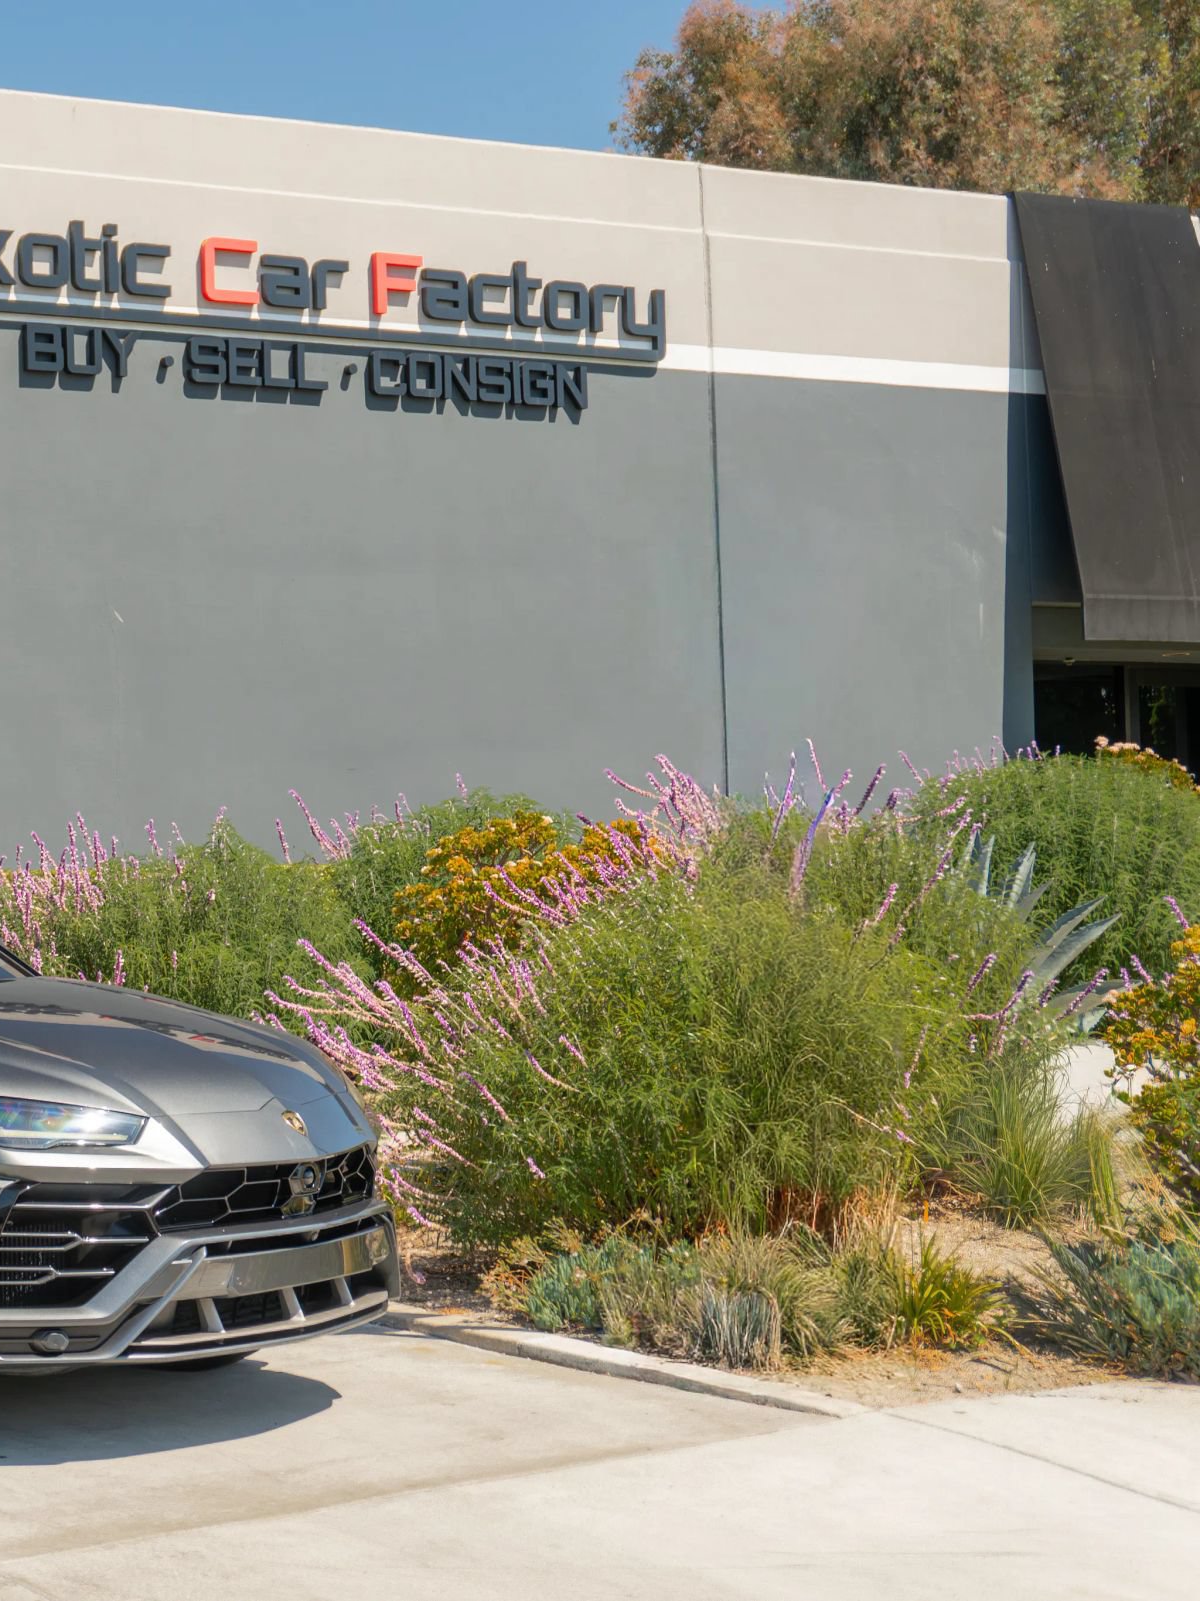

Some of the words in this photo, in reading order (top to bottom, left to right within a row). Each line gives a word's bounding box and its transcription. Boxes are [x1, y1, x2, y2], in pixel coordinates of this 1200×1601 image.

[200, 236, 350, 310] Car
[371, 251, 666, 362] Factory
[22, 323, 136, 379] BUY
[187, 336, 329, 391] SELL
[369, 350, 589, 410] CONSIGN
